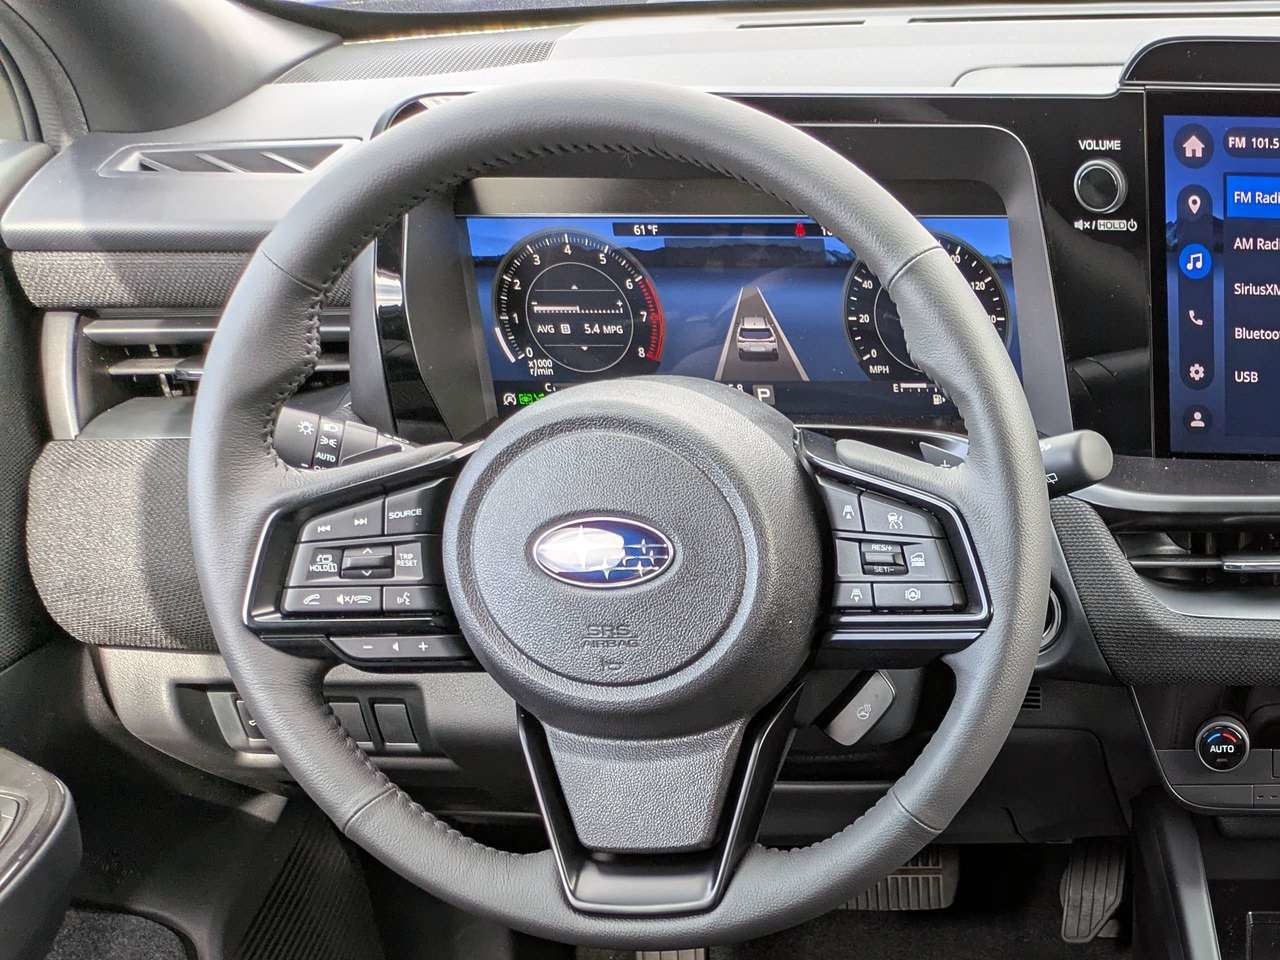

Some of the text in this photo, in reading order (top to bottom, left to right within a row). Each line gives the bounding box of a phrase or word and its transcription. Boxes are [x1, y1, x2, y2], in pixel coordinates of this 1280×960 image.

[1078, 140, 1121, 150] VOLUME
[1228, 136, 1279, 148] FM 101.5
[1234, 192, 1252, 204] FM
[1234, 238, 1252, 250] AM
[564, 245, 572, 254] 4
[533, 255, 540, 264] 3
[600, 254, 606, 264] 5
[513, 280, 522, 290] 2
[626, 280, 633, 289] 6
[862, 280, 872, 290] 40
[970, 281, 986, 290] 120
[514, 314, 518, 323] 1
[640, 312, 647, 322] 7
[859, 314, 870, 323] 20
[537, 324, 623, 334] AVG 5.4 MPG
[526, 348, 534, 358] 0
[638, 348, 646, 357] 8
[870, 348, 877, 358] 0
[528, 360, 552, 368] x1000
[530, 366, 554, 376] r/min
[870, 366, 889, 374] MPH
[1234, 370, 1258, 383] USB
[893, 384, 898, 392] E
[757, 388, 770, 401] P
[316, 452, 336, 462] AUTO
[388, 508, 422, 519] SOURCE
[587, 626, 631, 638] SRS
[582, 639, 641, 648] AIRBAG
[1210, 744, 1234, 752] AUTO
